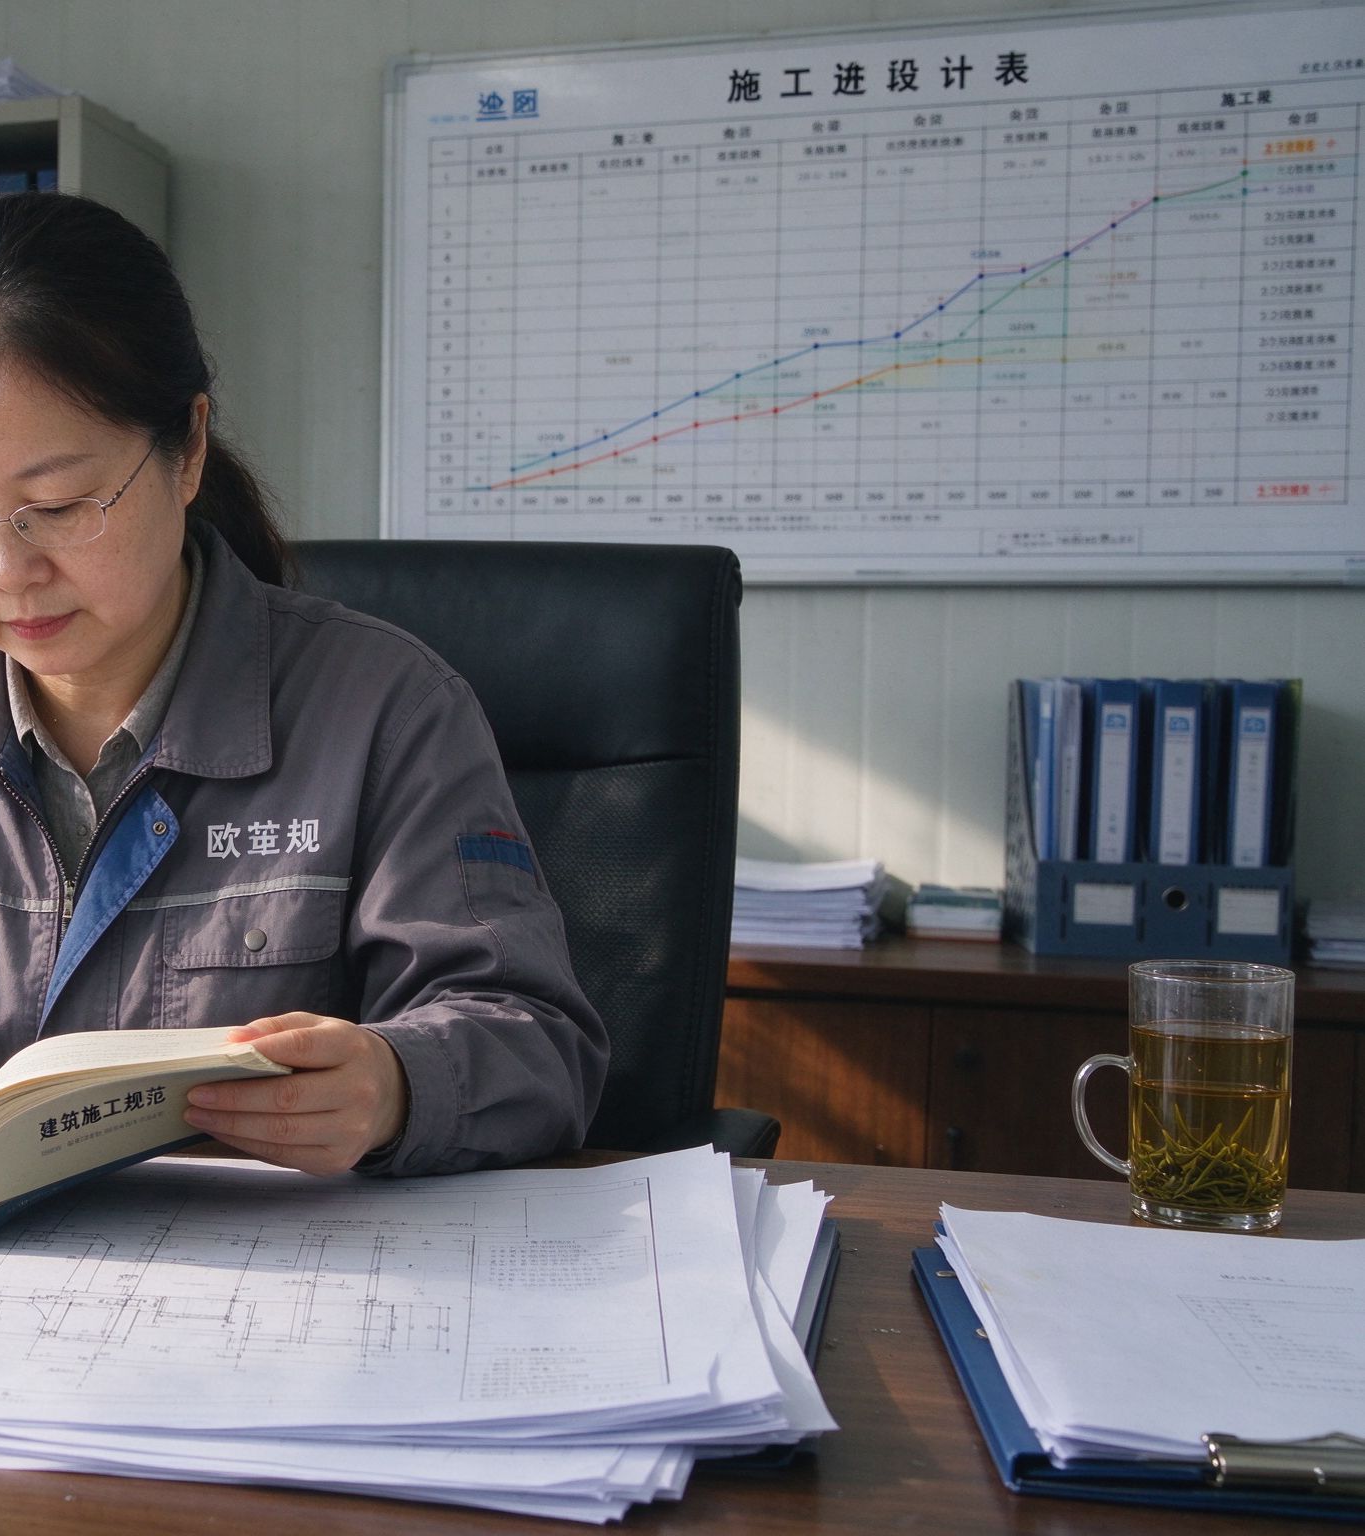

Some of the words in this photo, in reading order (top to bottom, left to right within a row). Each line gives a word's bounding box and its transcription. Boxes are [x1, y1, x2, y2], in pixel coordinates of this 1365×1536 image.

[38, 1086, 166, 1141] 建筑施工规范
